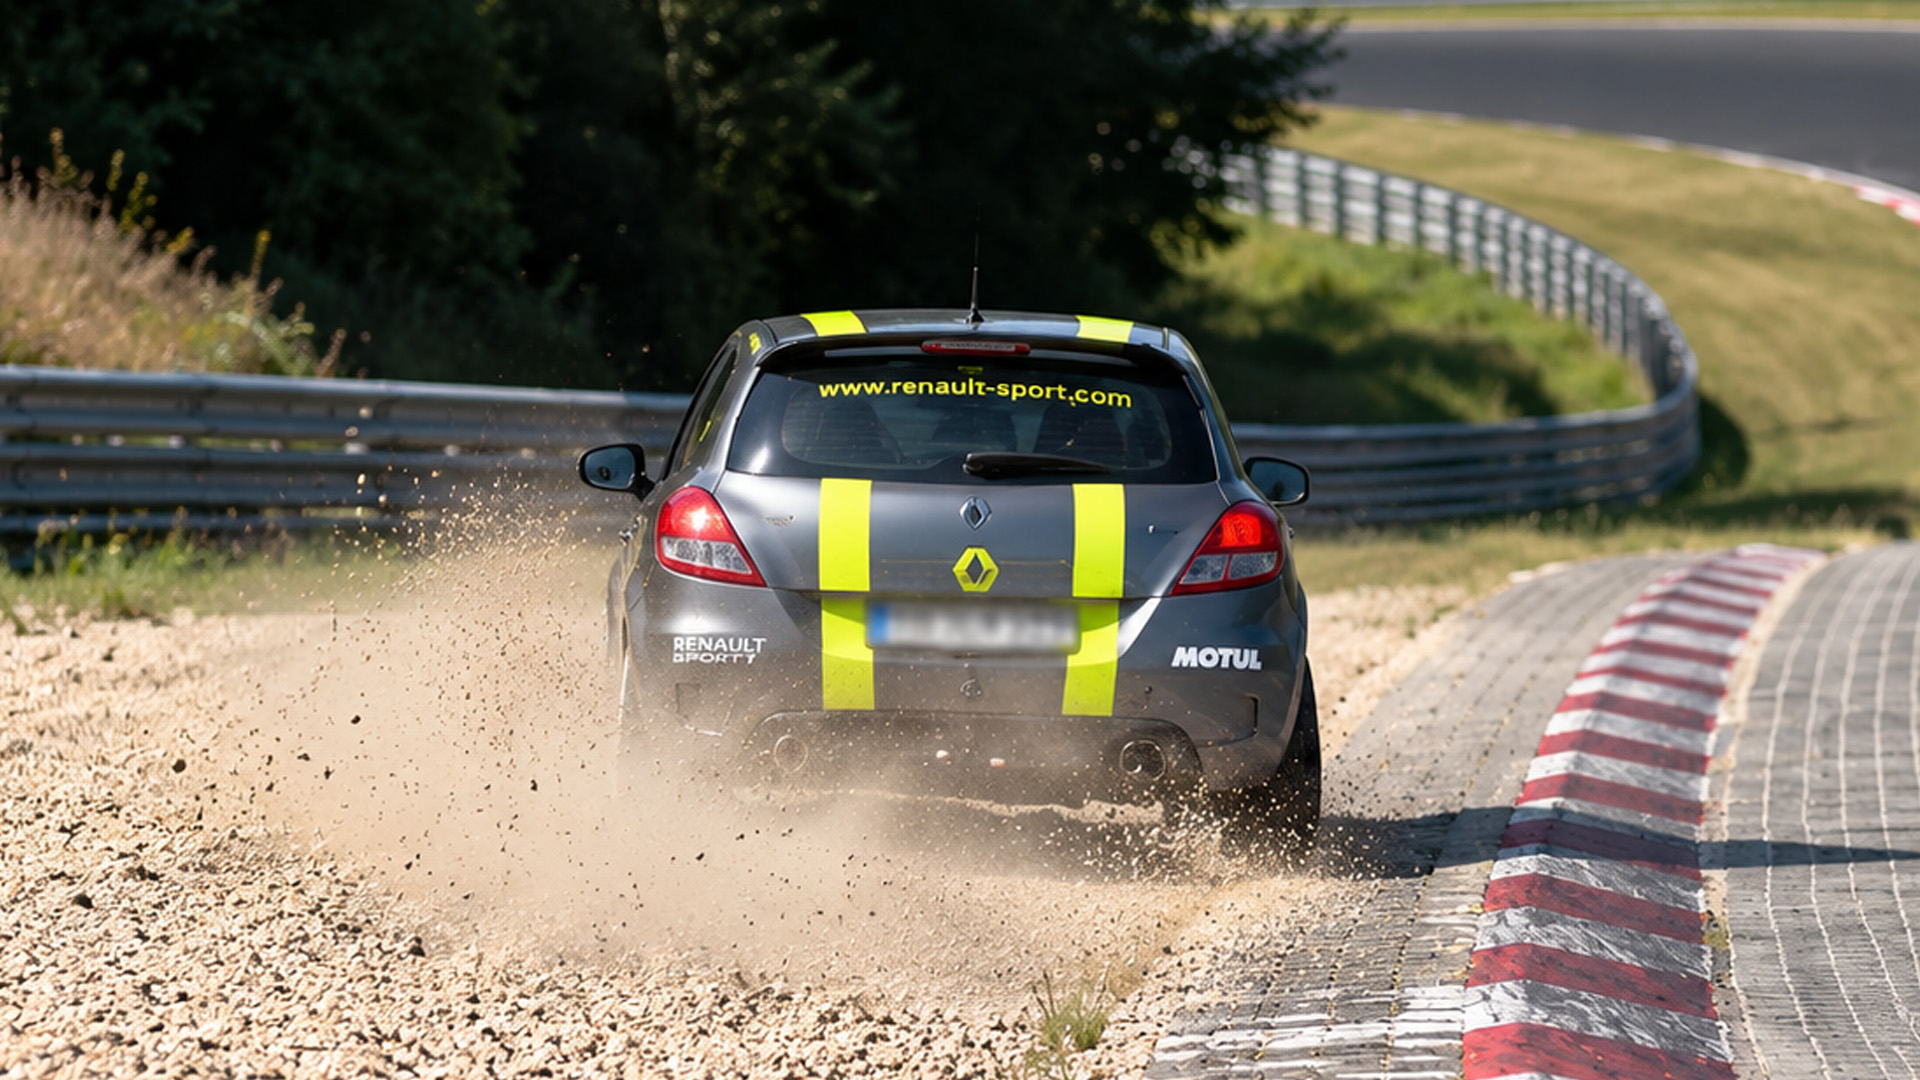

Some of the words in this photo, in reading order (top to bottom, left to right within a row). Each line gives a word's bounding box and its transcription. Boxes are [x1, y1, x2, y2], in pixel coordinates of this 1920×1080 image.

[819, 378, 1132, 407] www.renault-sport.com
[673, 636, 767, 653] RENAULT
[1171, 646, 1262, 670] MOTUL
